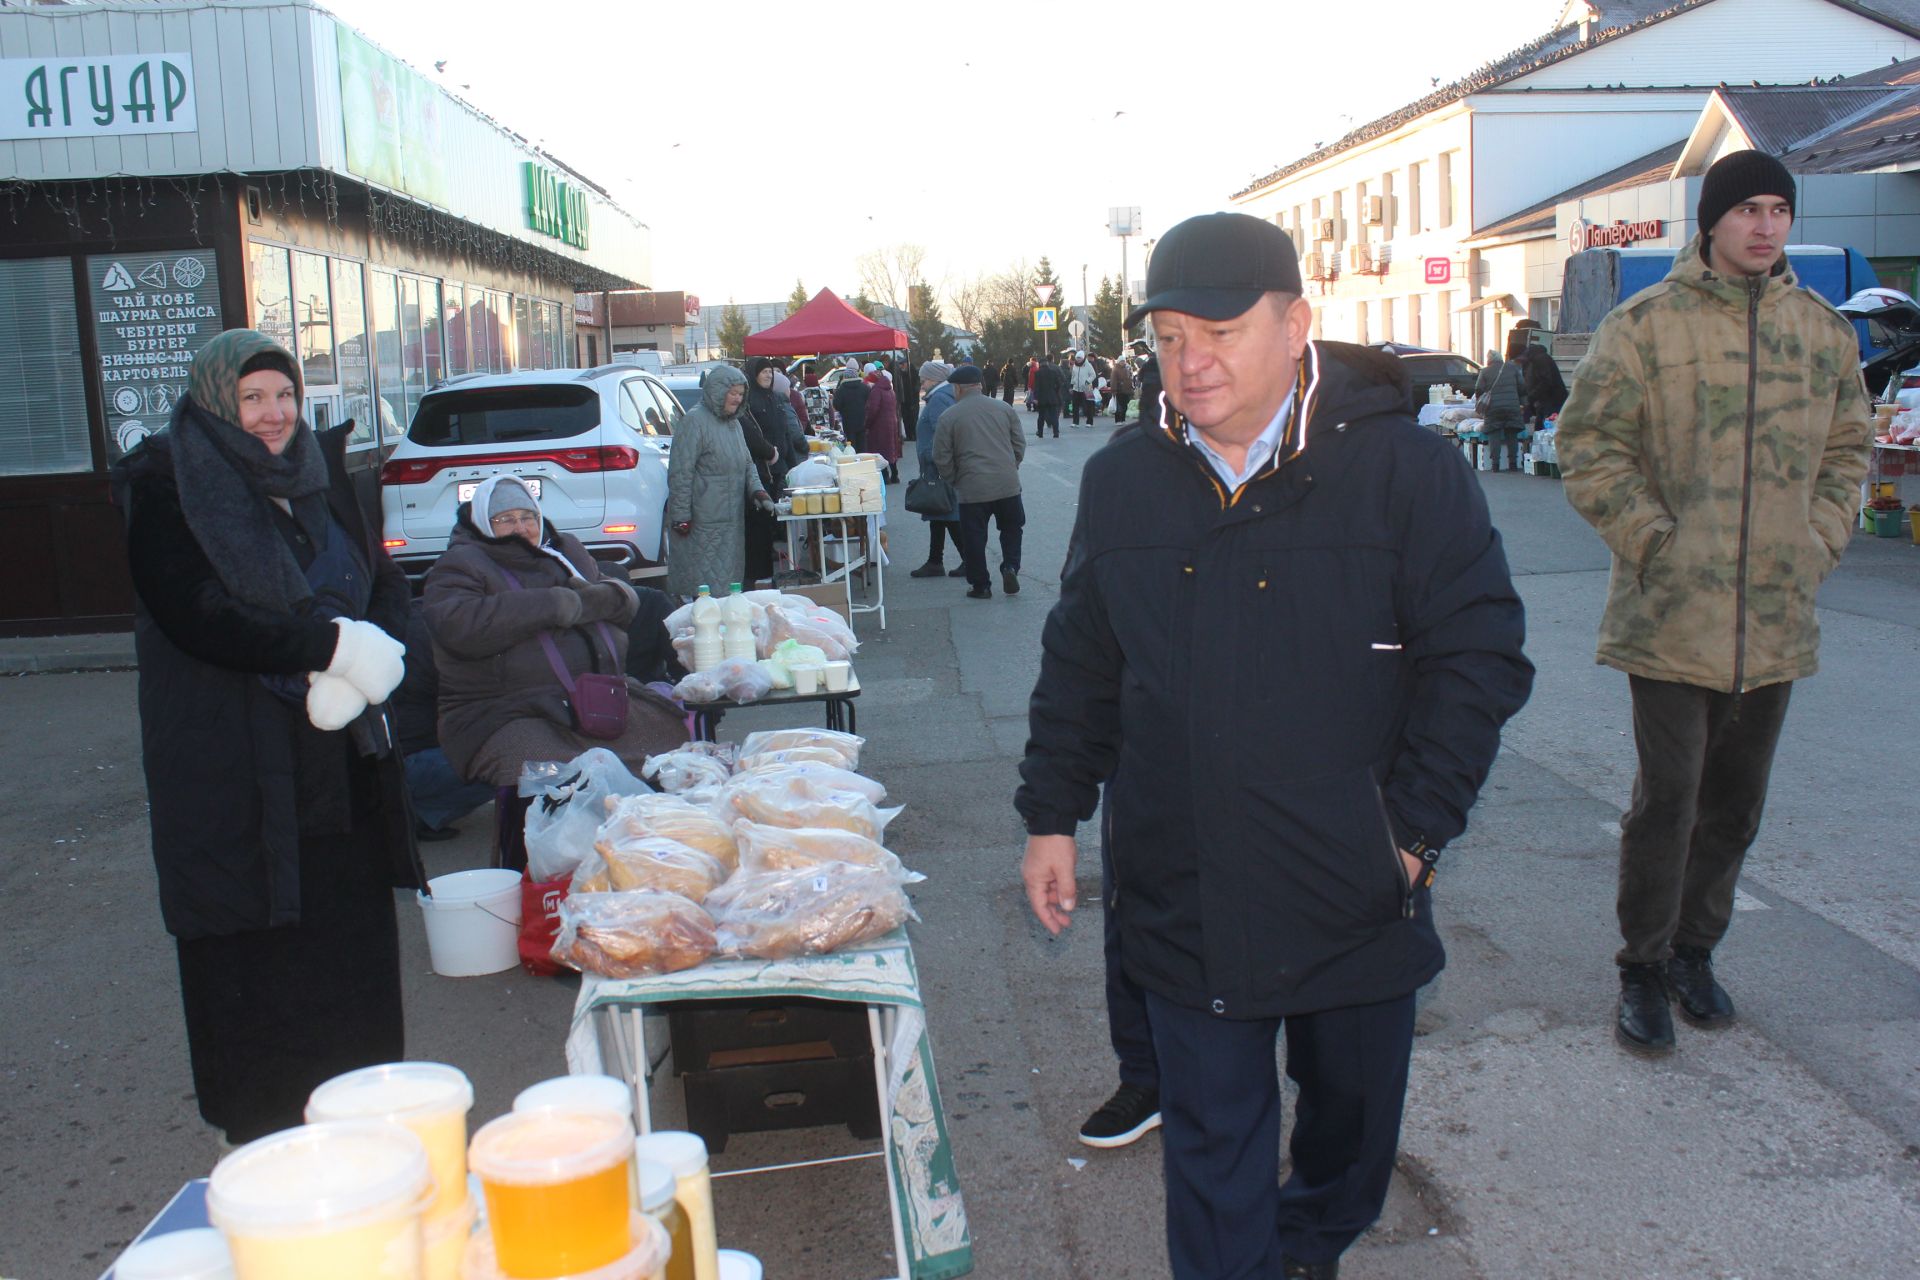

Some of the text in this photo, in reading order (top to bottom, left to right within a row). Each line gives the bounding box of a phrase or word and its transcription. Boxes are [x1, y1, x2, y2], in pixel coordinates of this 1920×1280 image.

[25, 60, 187, 127] ЯГУАР
[1586, 219, 1662, 248] Пятёрочка
[113, 292, 195, 308] ЧАЙ КОФЕ
[99, 306, 216, 323] ШАУРМА САМСА
[116, 323, 197, 338] ЧЕБУРЕКИ
[127, 337, 188, 351] БУРГЕР
[101, 350, 198, 367] БИЗНЕС-ЛА
[103, 366, 189, 382] КАРТОФЕЛЬ
